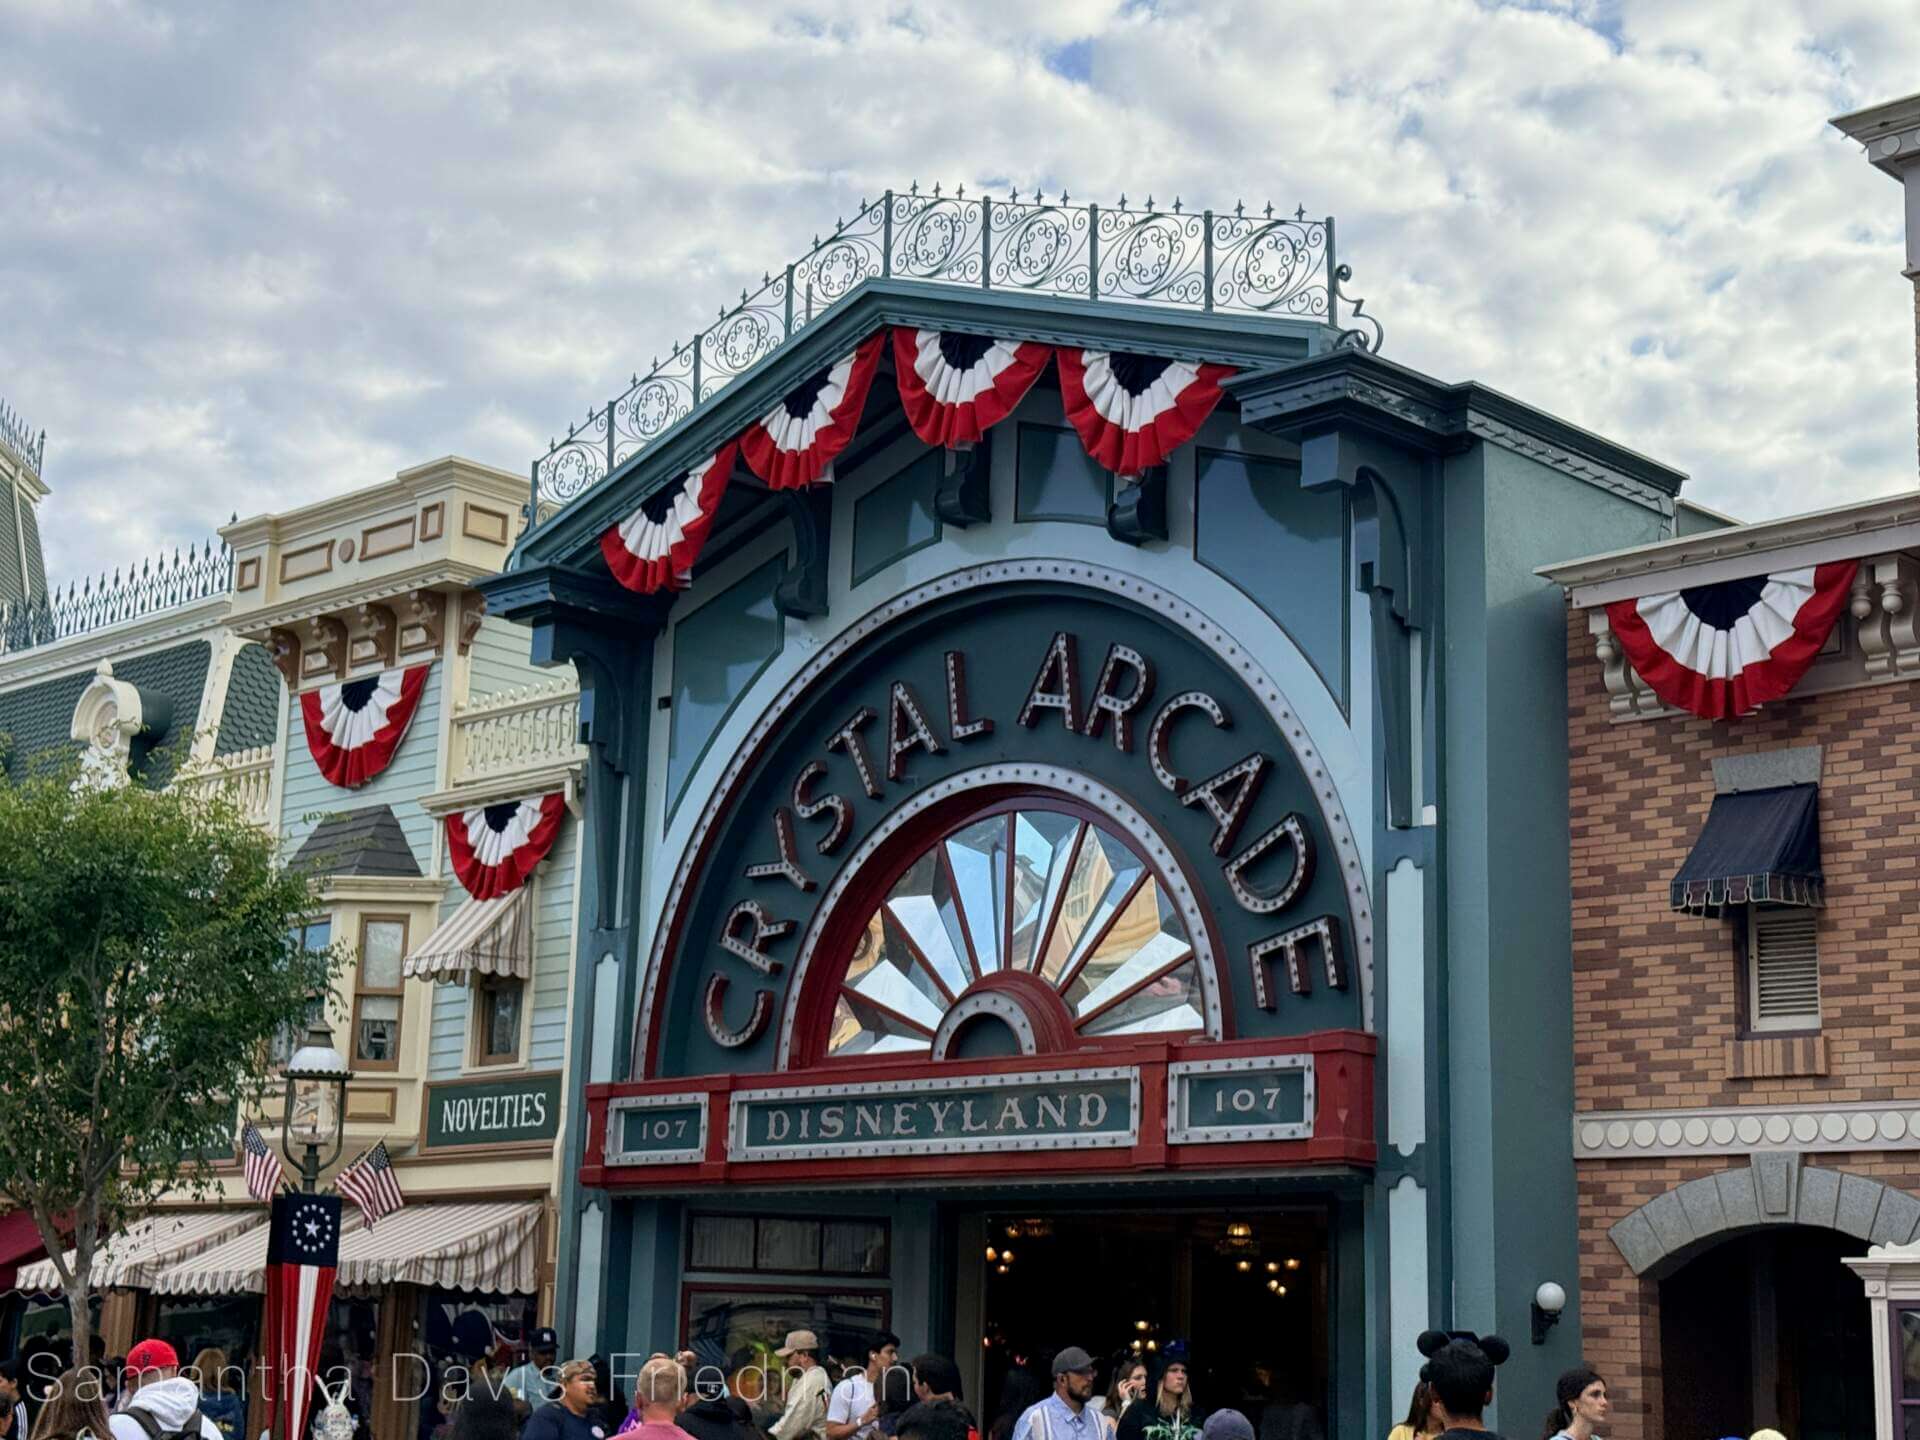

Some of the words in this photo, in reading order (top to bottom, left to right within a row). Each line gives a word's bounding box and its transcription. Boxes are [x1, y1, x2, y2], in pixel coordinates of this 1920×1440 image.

[705, 650, 994, 1048] CRYSTAL
[1016, 631, 1347, 1012] ARCADE
[441, 1091, 547, 1133] NOVELTIES
[766, 1091, 1108, 1141] DISNEYLAND
[1215, 1087, 1281, 1113] 107
[641, 1119, 688, 1141] 107
